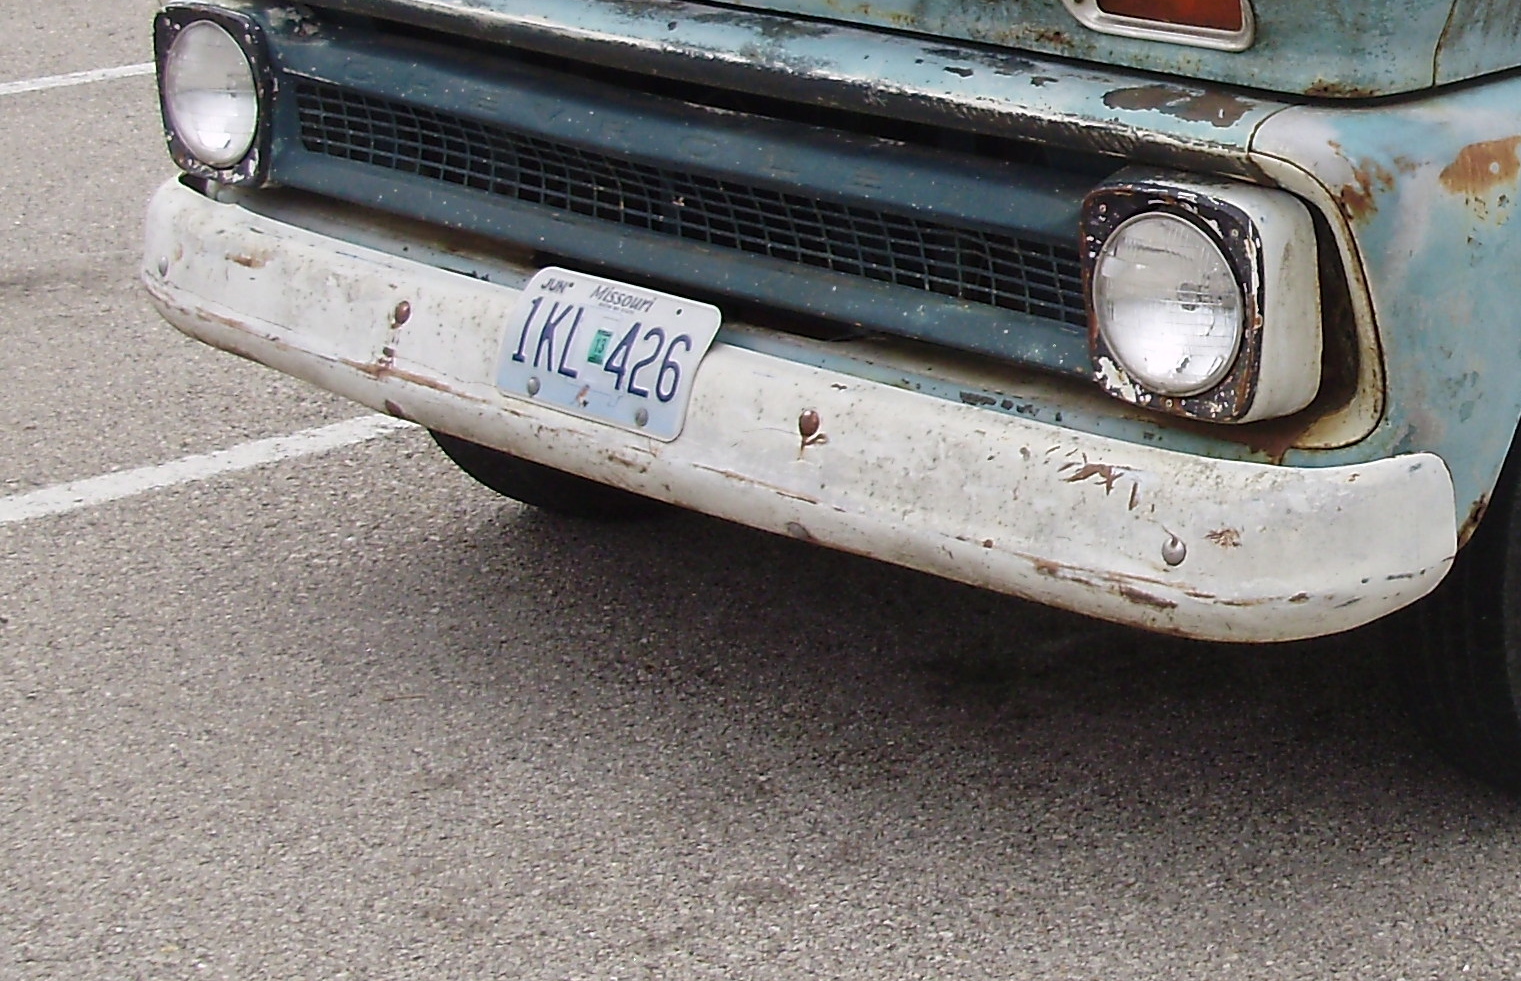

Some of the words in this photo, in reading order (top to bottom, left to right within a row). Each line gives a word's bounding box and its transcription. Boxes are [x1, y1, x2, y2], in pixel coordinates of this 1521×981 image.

[541, 278, 568, 294] JUN
[589, 284, 658, 313] Missouri
[512, 296, 585, 379] 1KL
[604, 321, 693, 403] 426
